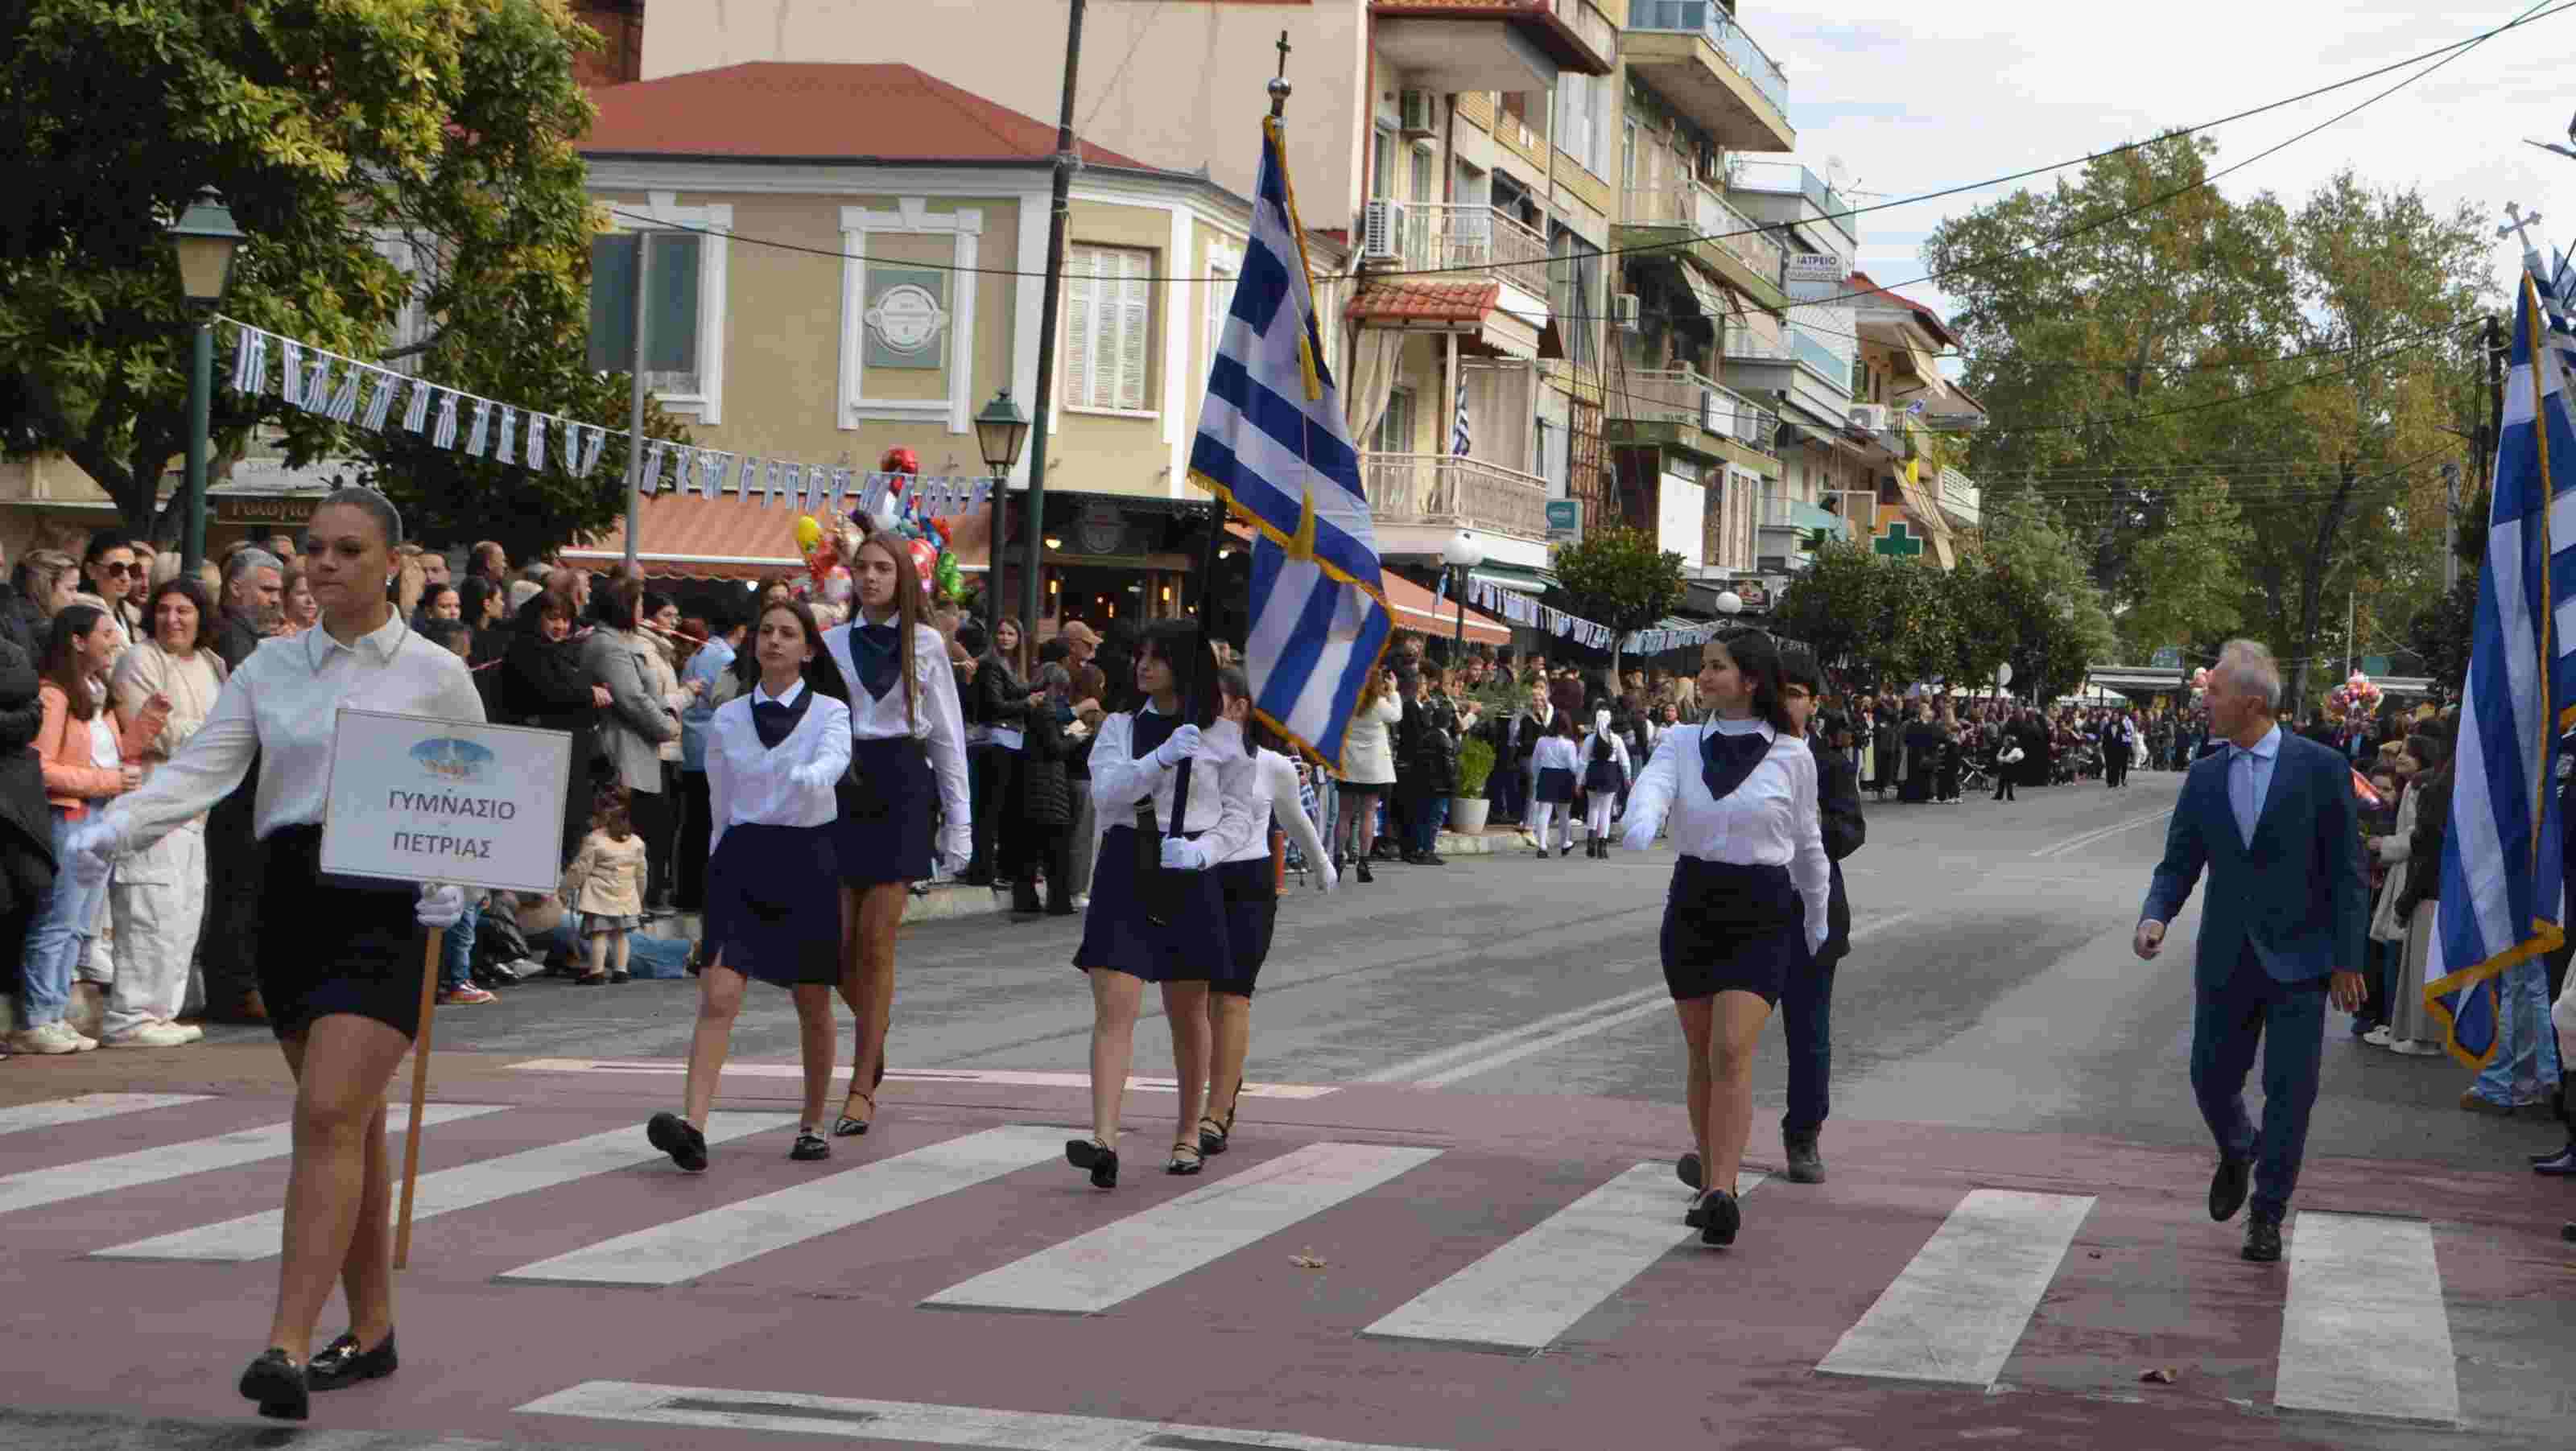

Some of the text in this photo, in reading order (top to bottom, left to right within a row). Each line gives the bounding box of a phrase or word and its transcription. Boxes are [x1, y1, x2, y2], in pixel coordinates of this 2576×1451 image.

[1797, 256, 1837, 265] ΙΑΤΡΕΙΟ
[389, 789, 516, 819] ΓΥΜΝΑΣΙΟ
[394, 831, 490, 858] ΠΕΤΡΙΑΣ
